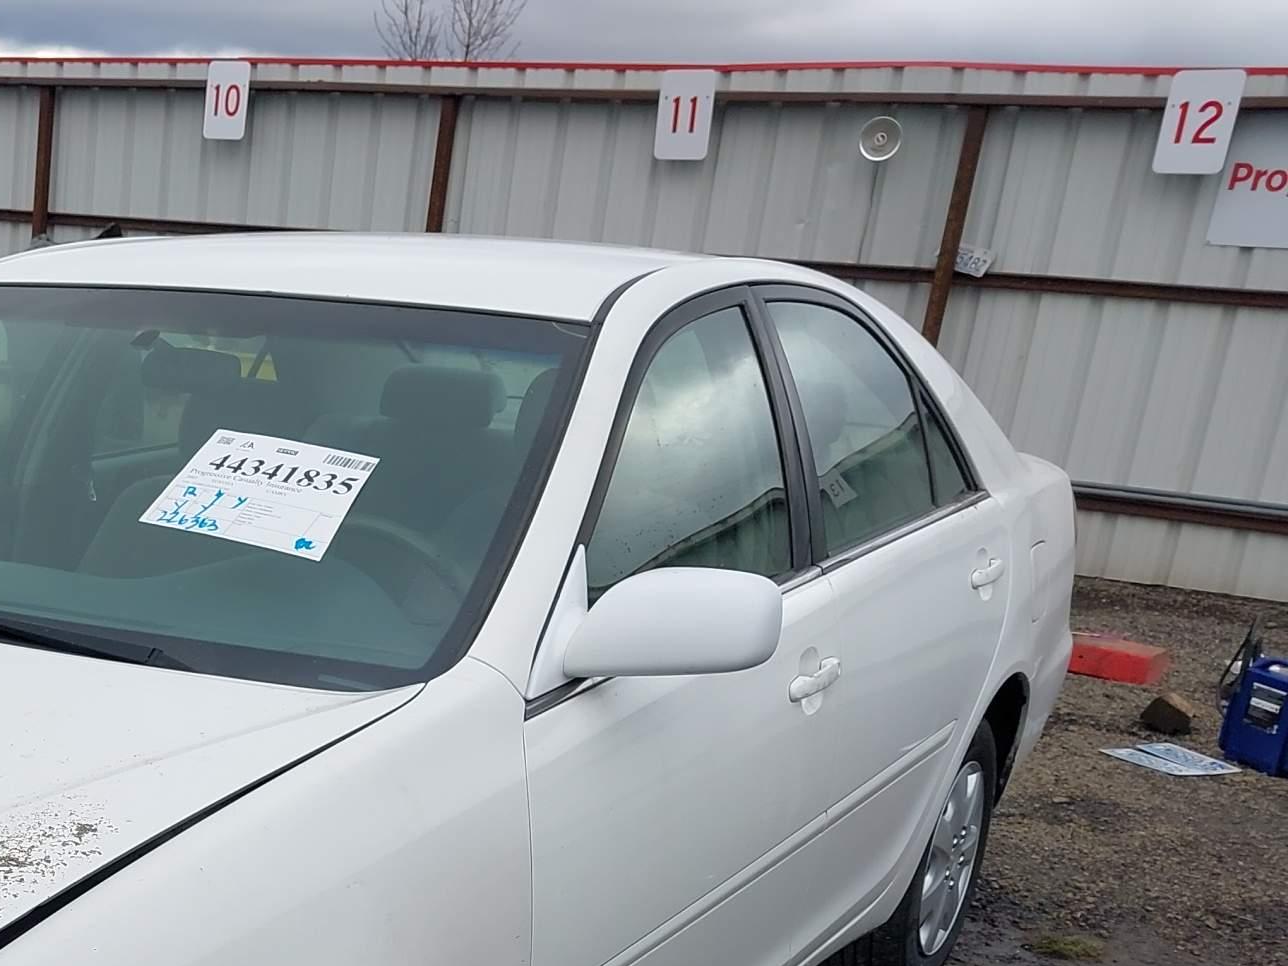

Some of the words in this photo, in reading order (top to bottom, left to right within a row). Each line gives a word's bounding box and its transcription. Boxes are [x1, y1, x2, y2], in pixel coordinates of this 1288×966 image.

[211, 83, 241, 118] 10
[671, 96, 698, 133] 11
[1173, 100, 1224, 145] 12
[1227, 162, 1288, 193] Pro
[209, 454, 361, 496] 44341835
